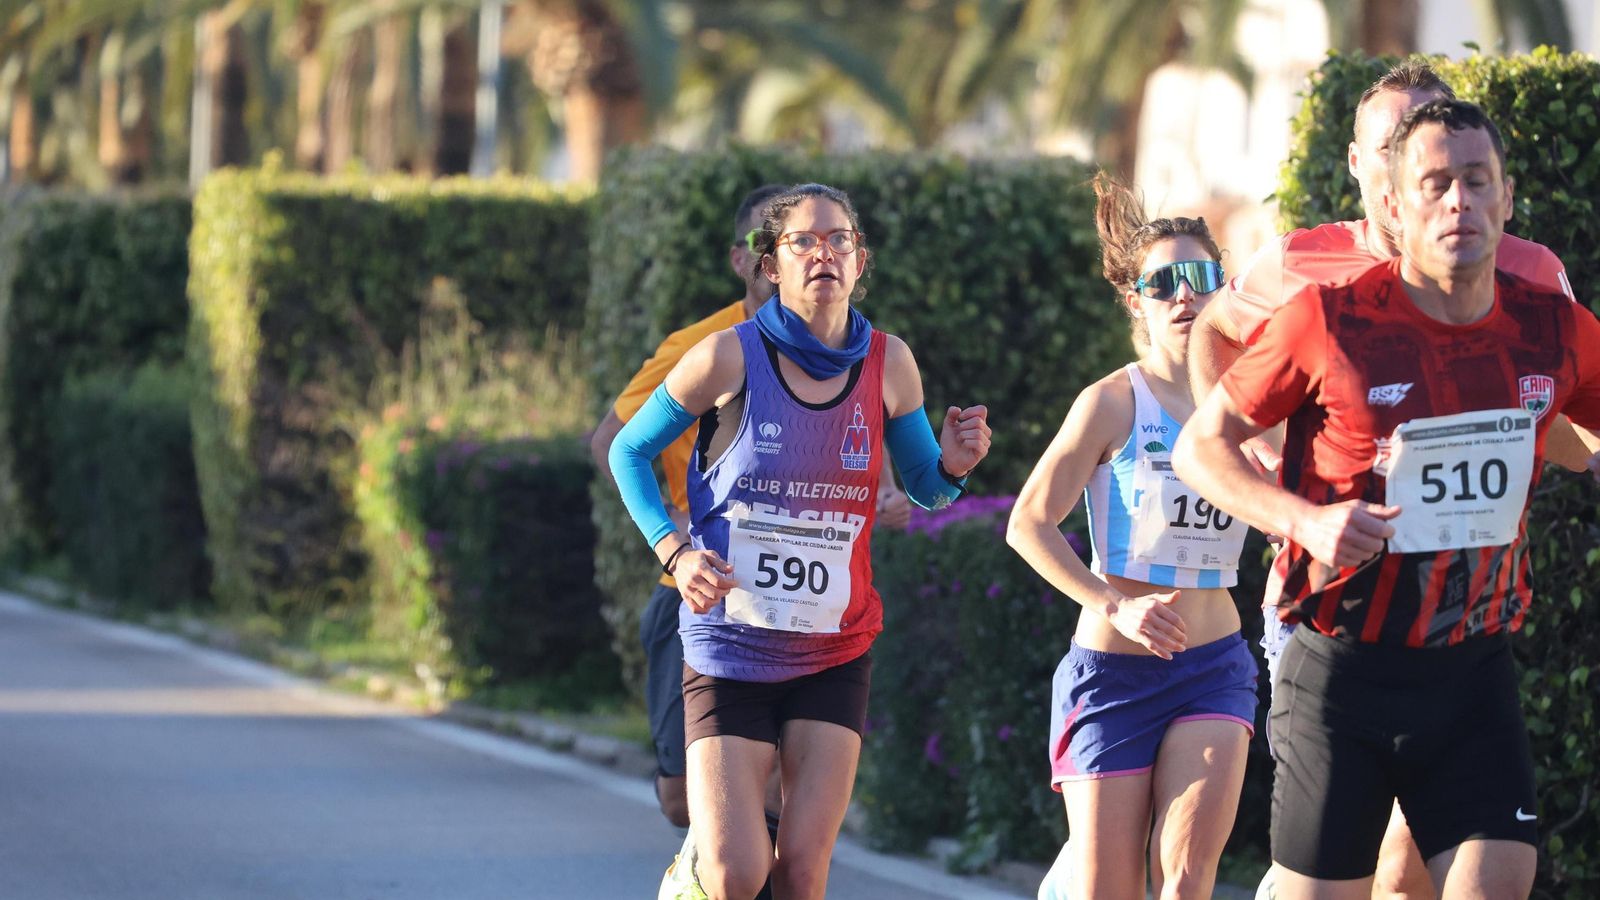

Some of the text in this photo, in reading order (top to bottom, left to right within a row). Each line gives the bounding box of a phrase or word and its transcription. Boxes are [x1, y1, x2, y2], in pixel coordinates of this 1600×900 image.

[1141, 423, 1169, 434] vive
[737, 476, 870, 502] CLUB ATLETISMO
[1421, 458, 1508, 504] 510
[1169, 494, 1233, 531] 190
[755, 535, 780, 543] CARRERA
[780, 538, 802, 547] POPULAR
[755, 553, 829, 595] 590
[799, 599, 818, 607] CASTILLO
